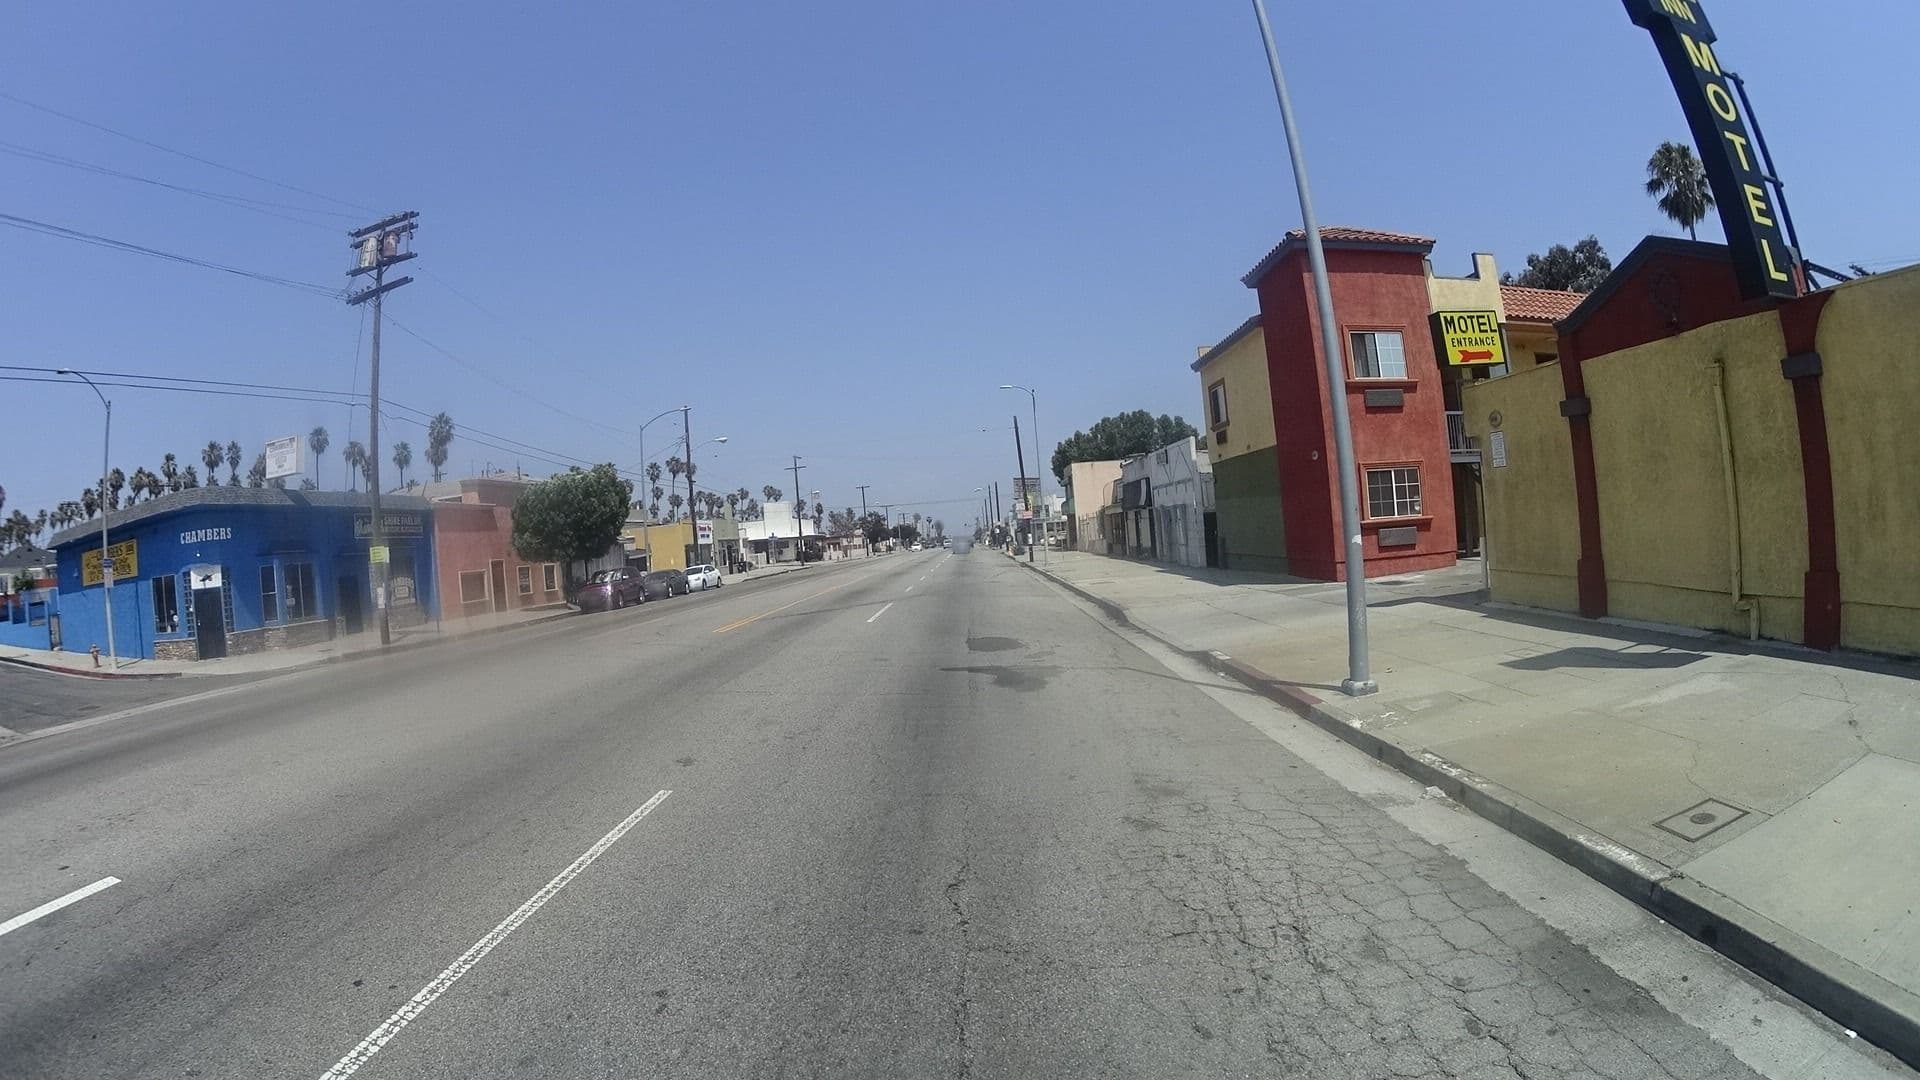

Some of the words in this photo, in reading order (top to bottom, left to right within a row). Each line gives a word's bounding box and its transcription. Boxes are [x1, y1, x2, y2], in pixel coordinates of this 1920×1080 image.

[1681, 32, 1788, 283] MOTEL
[1443, 315, 1498, 335] MOTEL
[1451, 336, 1496, 348] ENTRANCE
[180, 527, 232, 544] CHAMBERS
